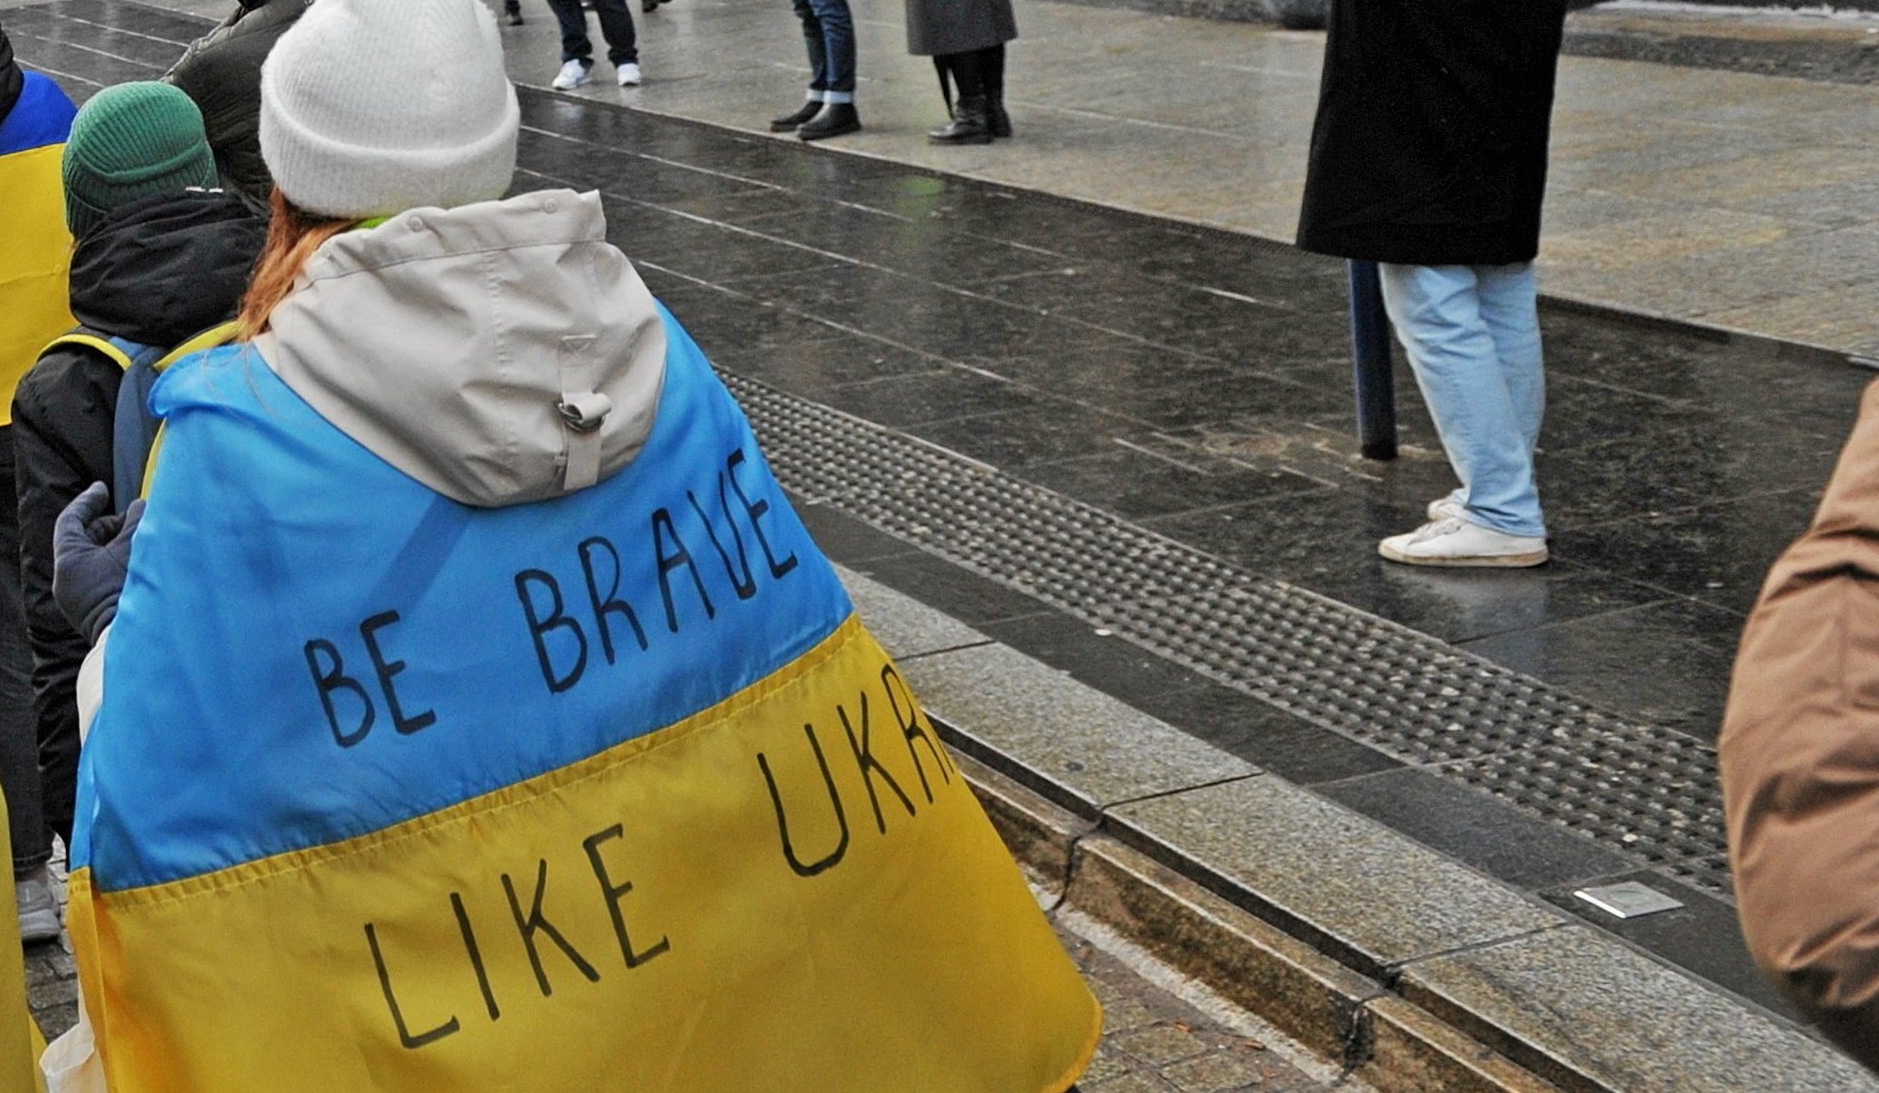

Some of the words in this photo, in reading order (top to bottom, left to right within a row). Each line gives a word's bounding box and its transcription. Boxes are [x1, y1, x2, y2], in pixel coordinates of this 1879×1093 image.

[303, 609, 436, 749] BE
[514, 447, 799, 694] BRAVE
[364, 823, 671, 1049] LIKE
